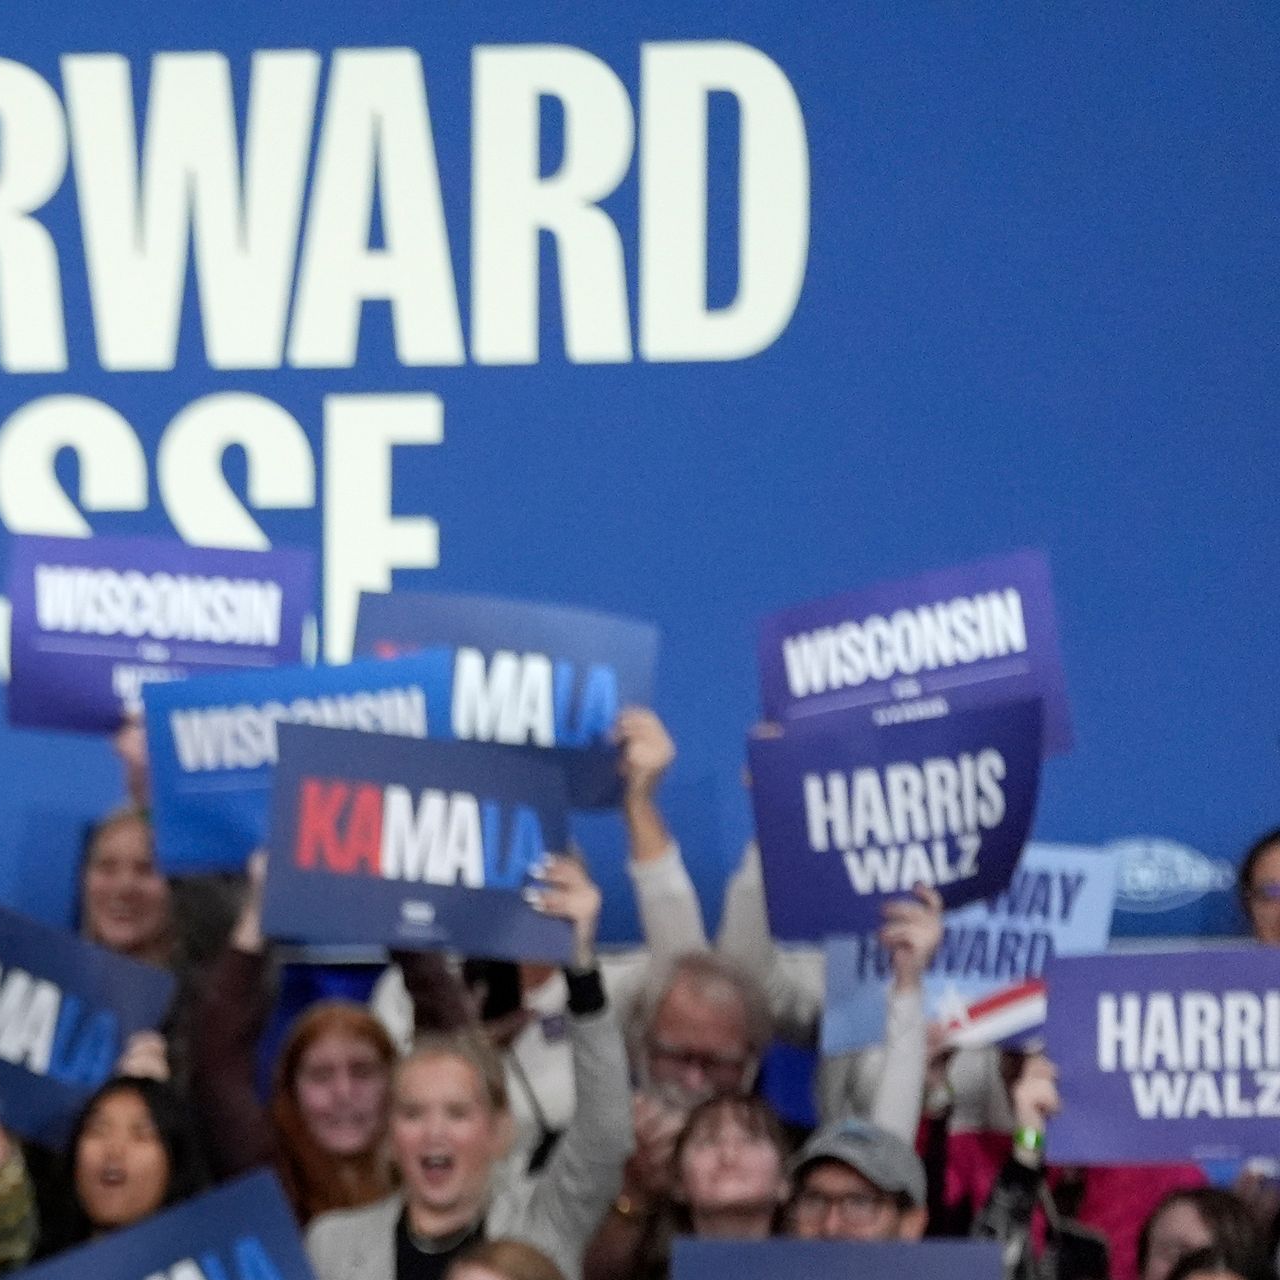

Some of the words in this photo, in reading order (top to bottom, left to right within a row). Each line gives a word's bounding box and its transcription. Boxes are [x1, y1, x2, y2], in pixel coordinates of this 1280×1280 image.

[34, 563, 283, 646] WISCONSIN
[782, 587, 1028, 699] WISCONSIN
[376, 642, 619, 748] MALA
[294, 775, 544, 890] KAMALA
[804, 748, 1007, 853] HARRIS
[842, 836, 981, 896] WALZ
[1097, 987, 1280, 1073] HARRI
[1129, 1070, 1280, 1120] WALZ
